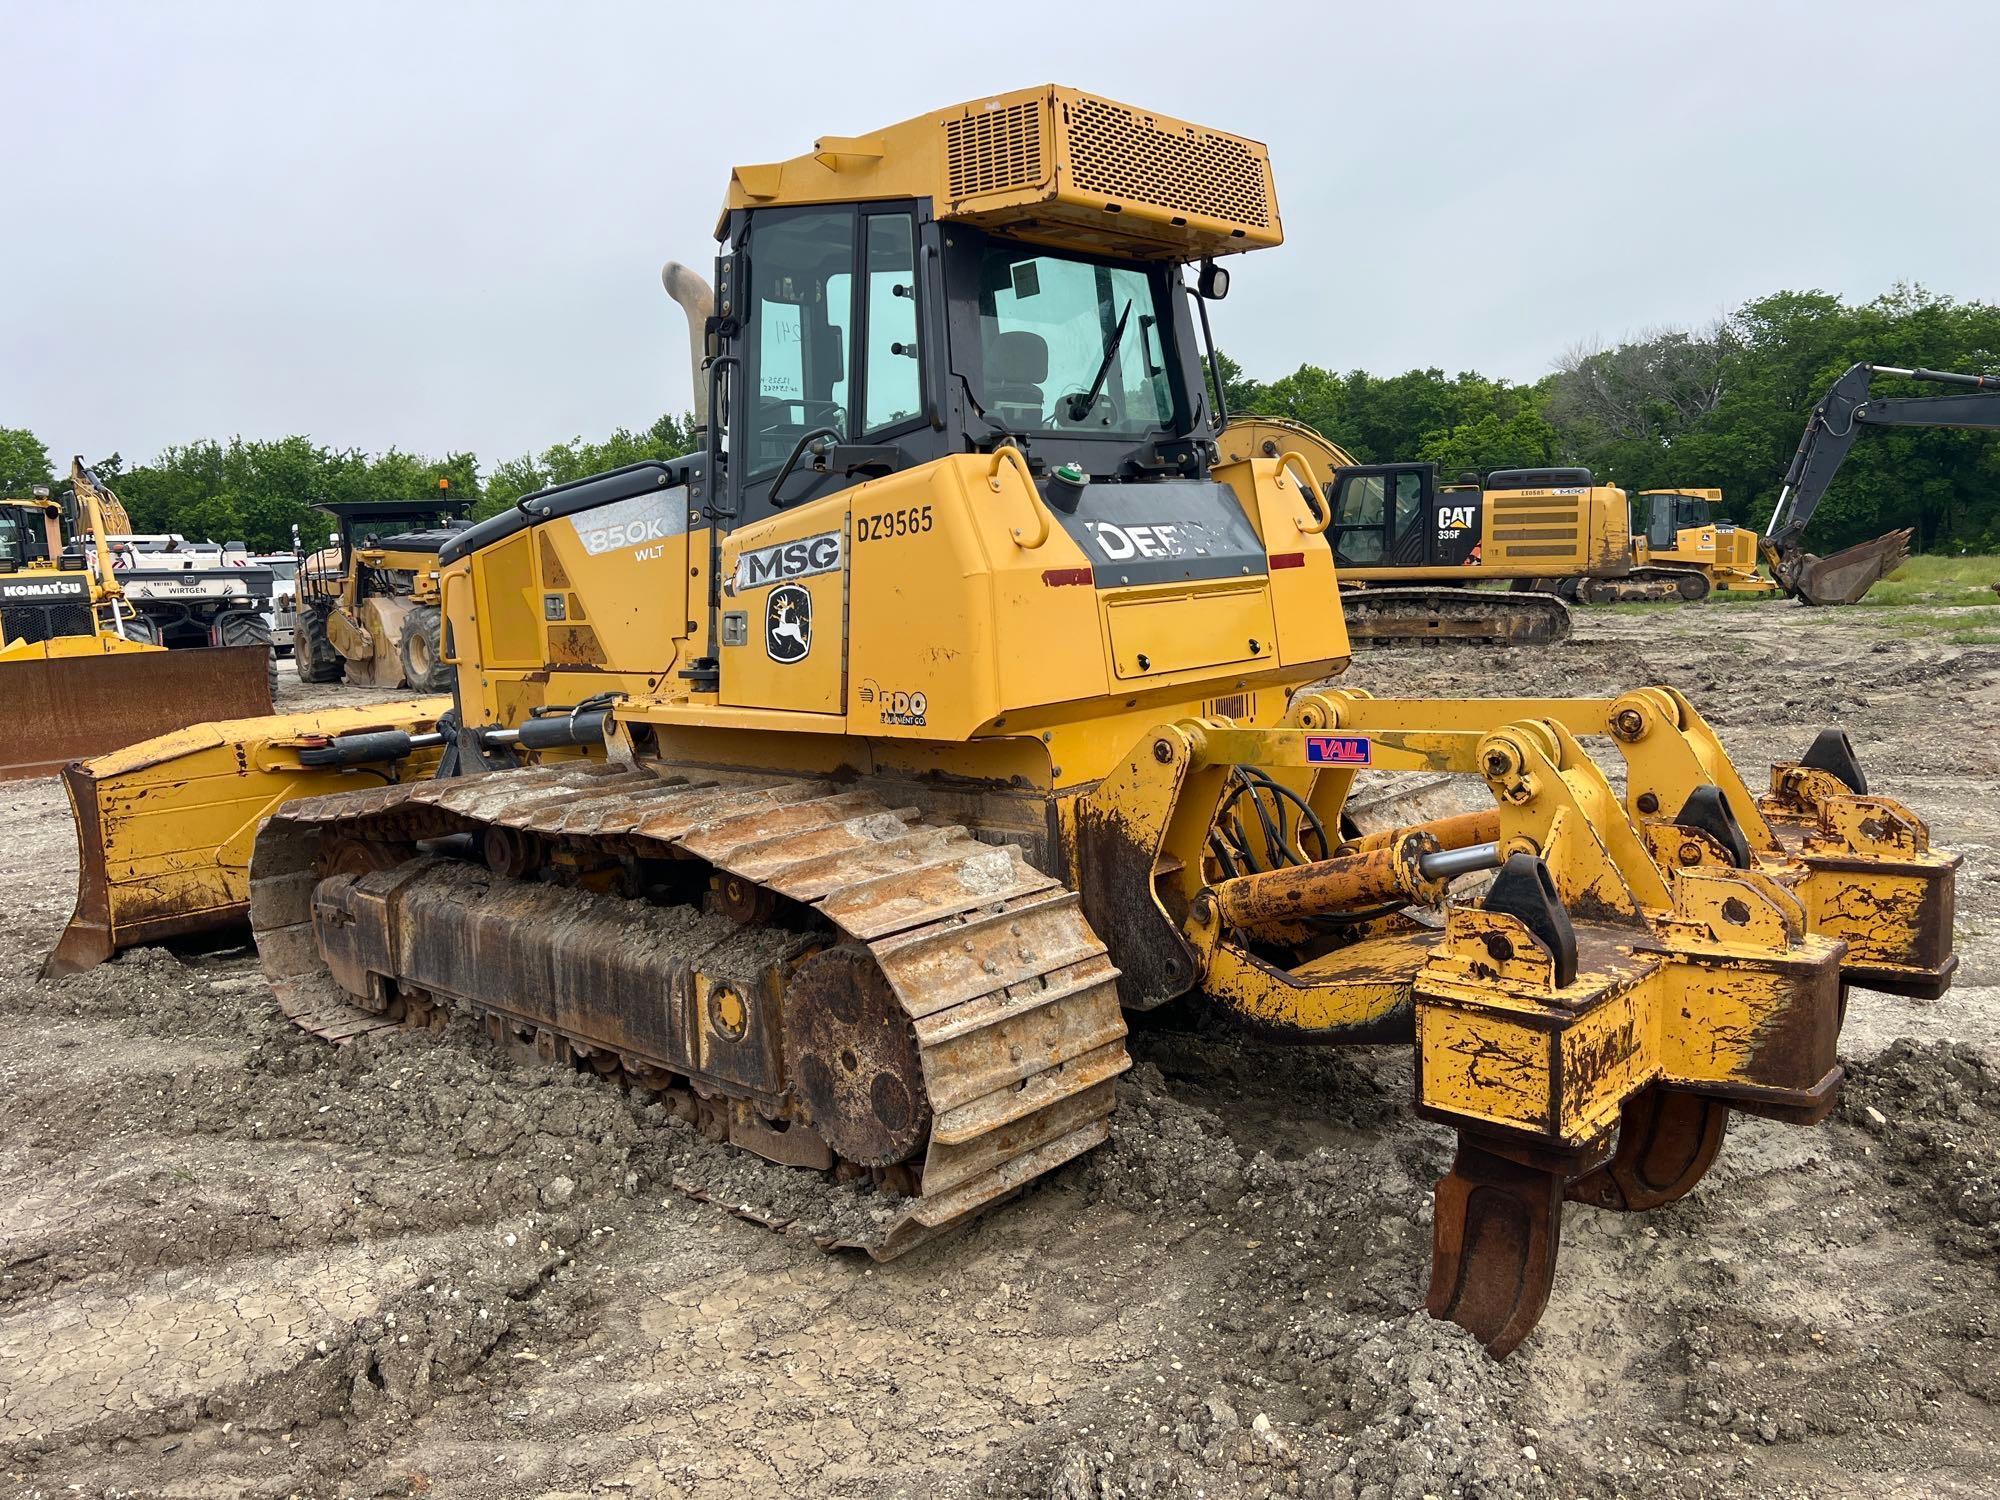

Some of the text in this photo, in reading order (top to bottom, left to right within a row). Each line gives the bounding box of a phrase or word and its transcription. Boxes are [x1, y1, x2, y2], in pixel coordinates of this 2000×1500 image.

[857, 506, 933, 542] DZ9565
[1438, 507, 1475, 529] CAT
[590, 518, 664, 553] 850K
[1084, 522, 1225, 560] DEE
[1438, 530, 1460, 540] 336F
[634, 545, 664, 562] WLT
[749, 537, 839, 584] MSG
[3, 581, 82, 597] KOMATSU
[880, 691, 928, 715] RDO
[1310, 739, 1366, 761] VAIL
